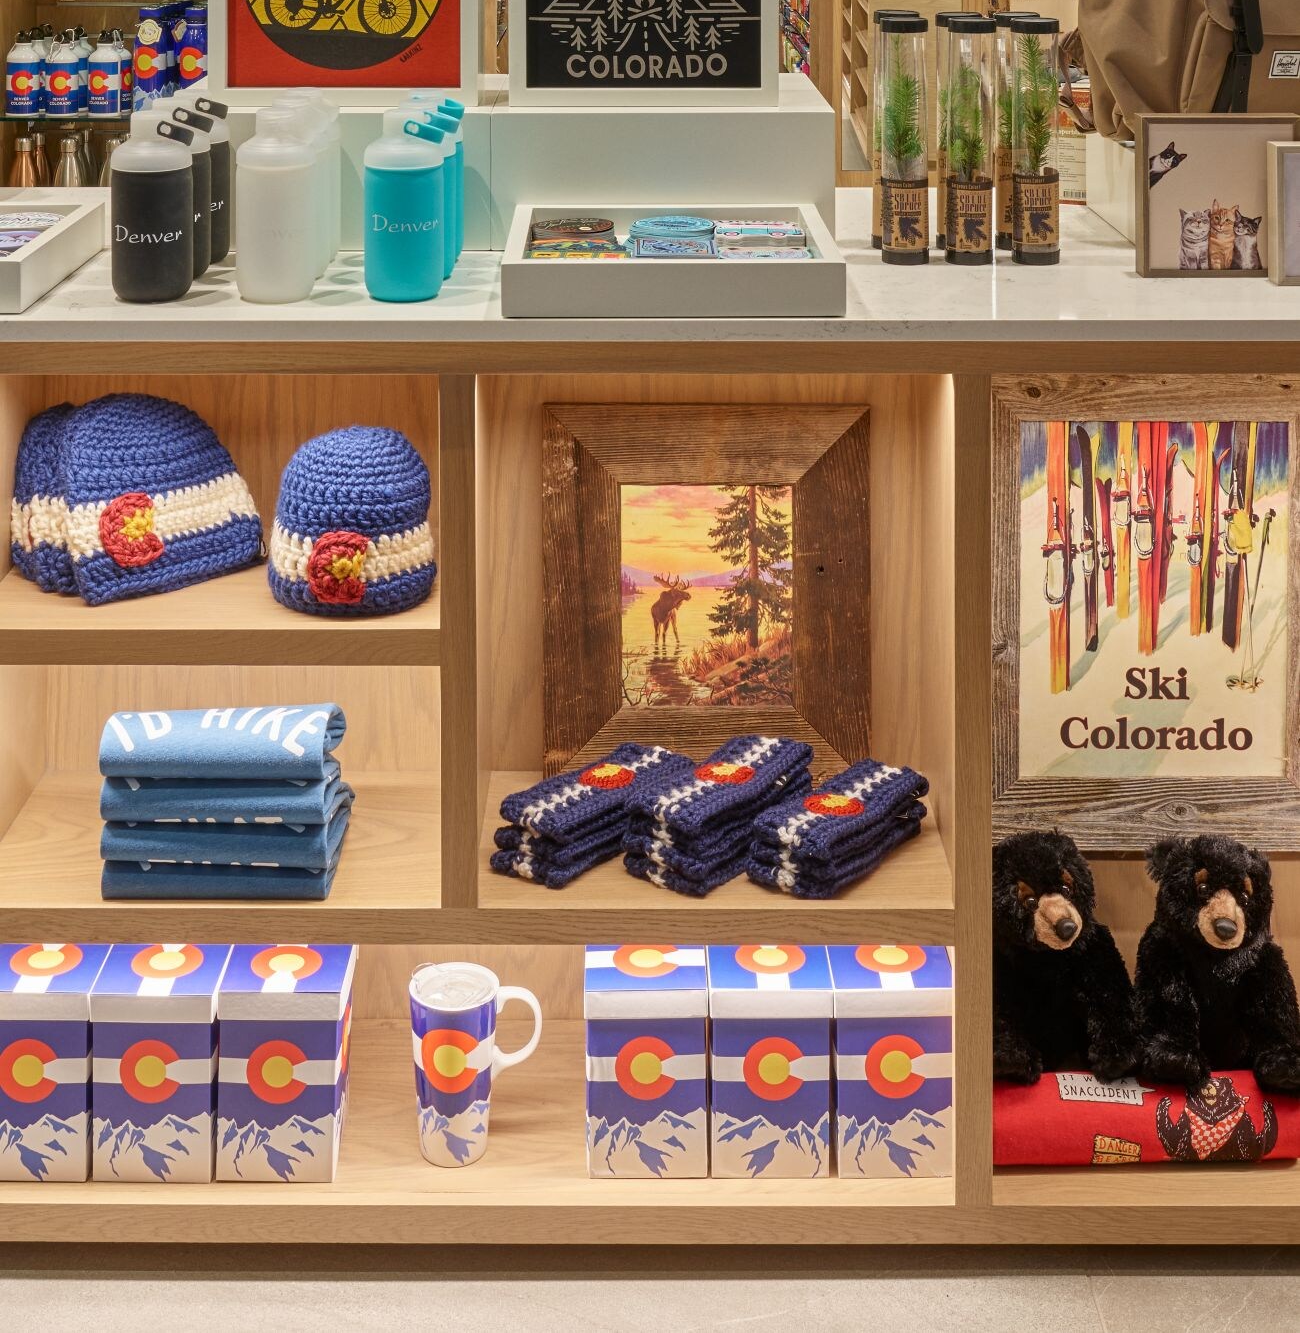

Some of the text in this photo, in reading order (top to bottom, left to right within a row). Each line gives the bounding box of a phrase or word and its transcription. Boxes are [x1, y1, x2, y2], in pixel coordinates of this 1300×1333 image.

[566, 52, 728, 79] COLORADO
[114, 224, 183, 244] Denver
[372, 213, 439, 233] Denver
[1124, 666, 1190, 700] Ski
[106, 707, 329, 757] I'D HIKE
[1060, 716, 1253, 751] Colorado
[1063, 1085, 1137, 1100] SNACCIDENT
[1099, 1137, 1138, 1155] DANGER
